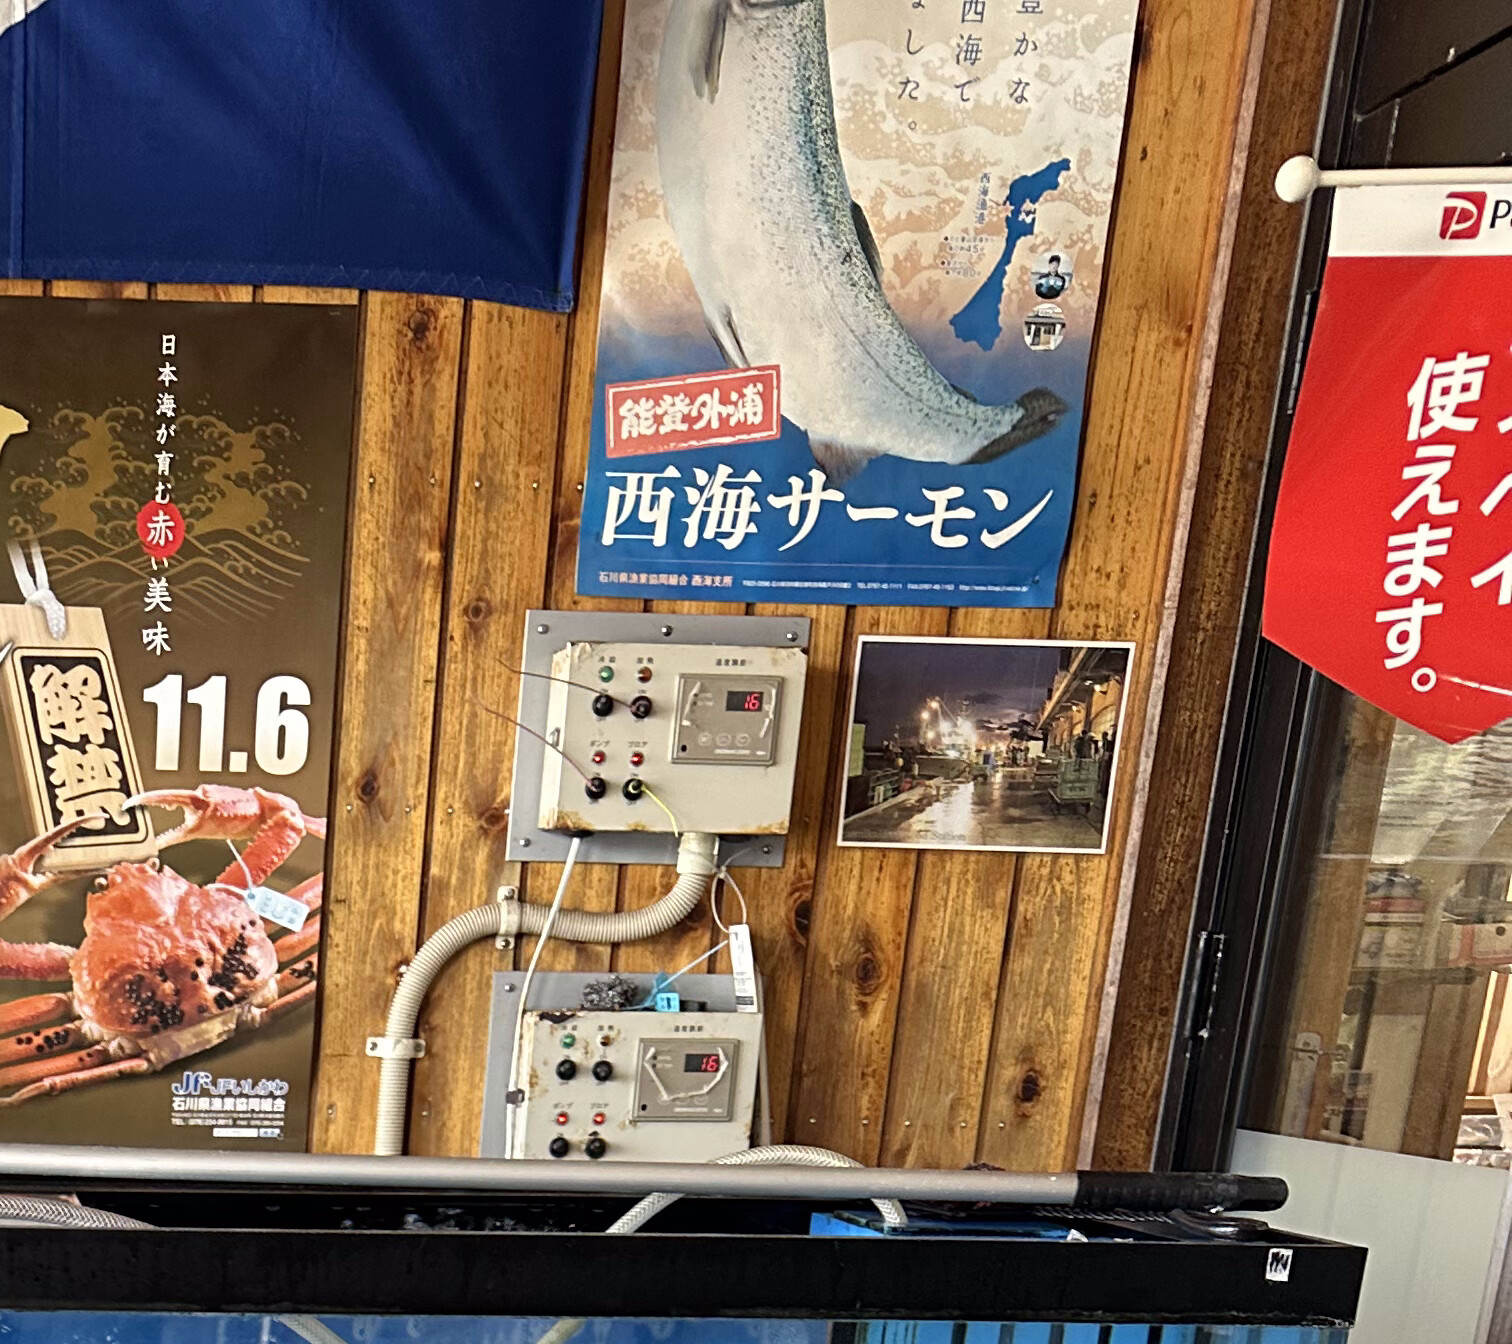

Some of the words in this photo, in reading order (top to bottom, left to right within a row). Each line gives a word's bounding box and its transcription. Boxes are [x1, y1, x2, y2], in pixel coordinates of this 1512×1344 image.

[619, 383, 765, 439] 能登外浦
[142, 333, 179, 656] 日本海が育む赤い美味
[600, 463, 1055, 551] 西海サーモン
[1375, 351, 1491, 693] 使えます。
[143, 673, 312, 776] 11.6
[743, 693, 761, 711] 16
